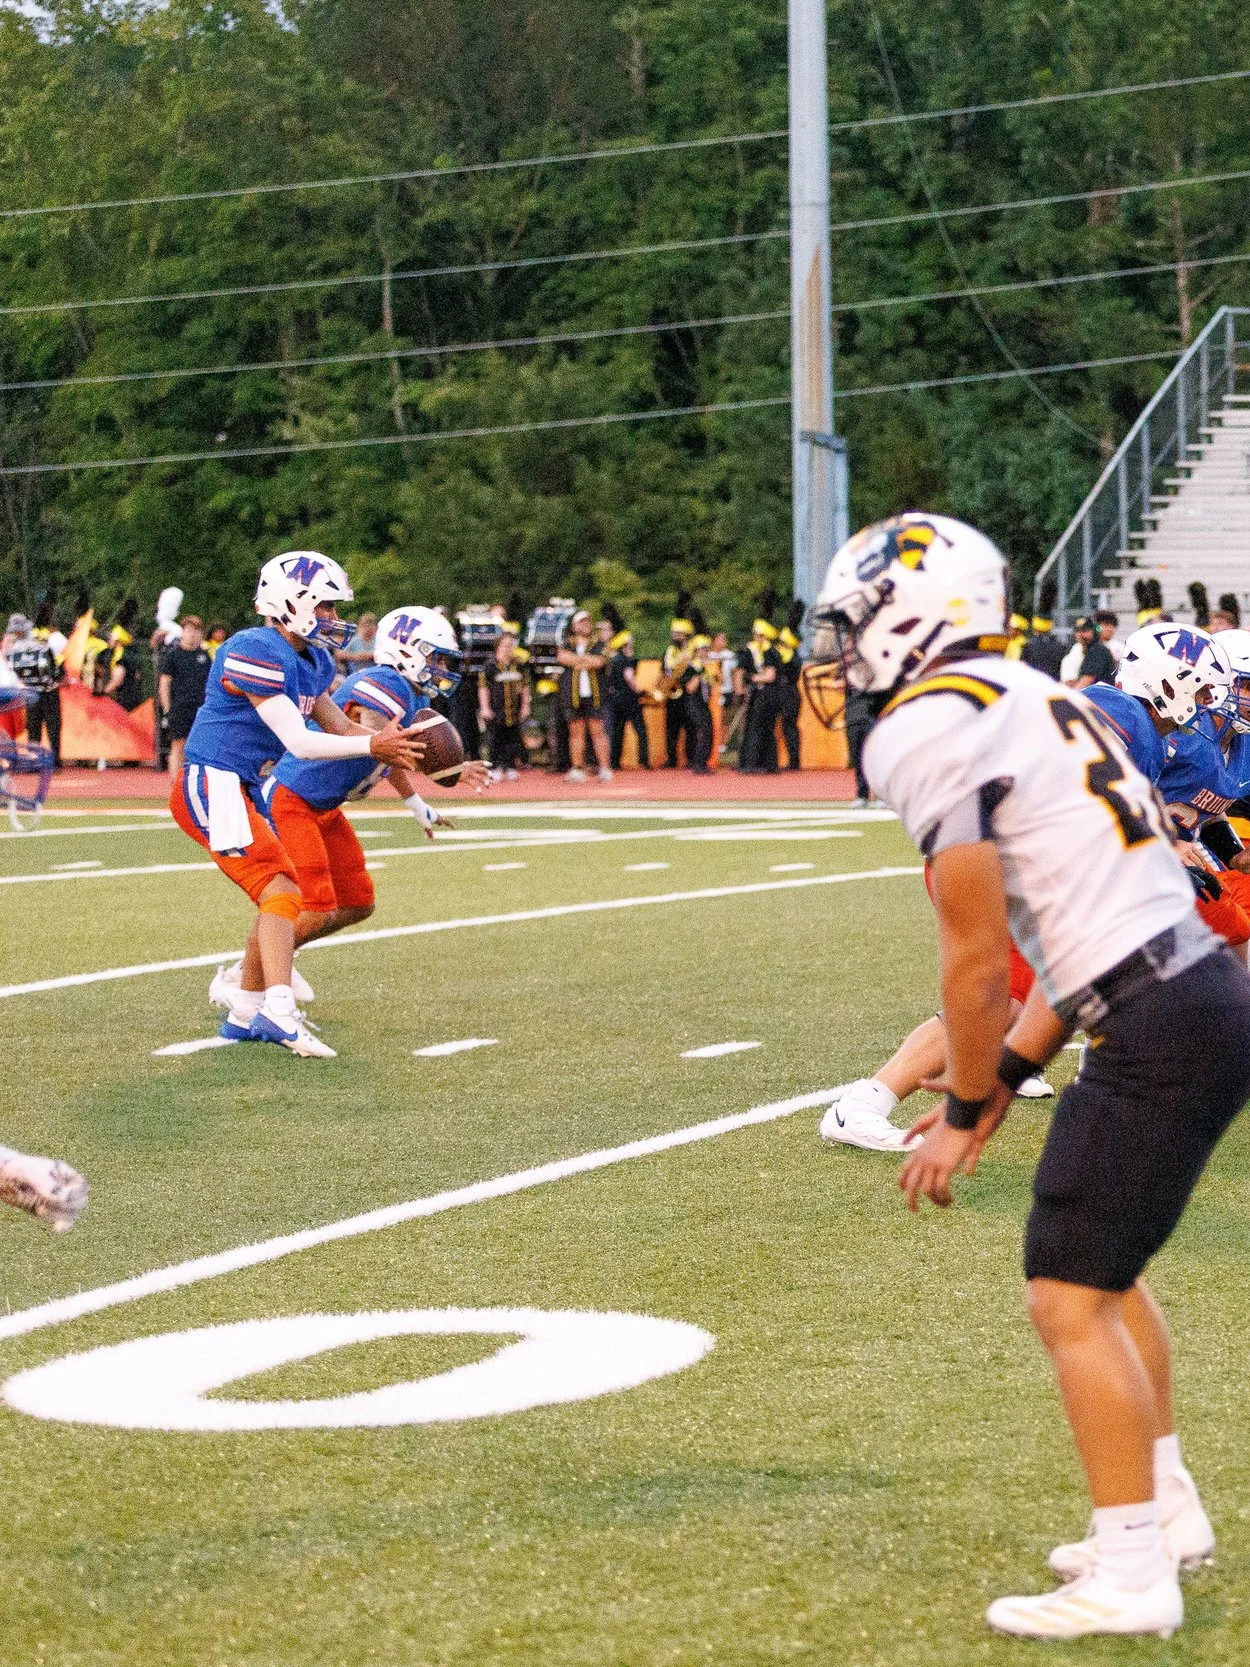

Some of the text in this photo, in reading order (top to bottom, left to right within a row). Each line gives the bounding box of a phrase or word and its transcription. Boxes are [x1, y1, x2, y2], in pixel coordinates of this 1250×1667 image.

[286, 556, 325, 587] N
[388, 613, 422, 645] N
[1167, 628, 1211, 668] N
